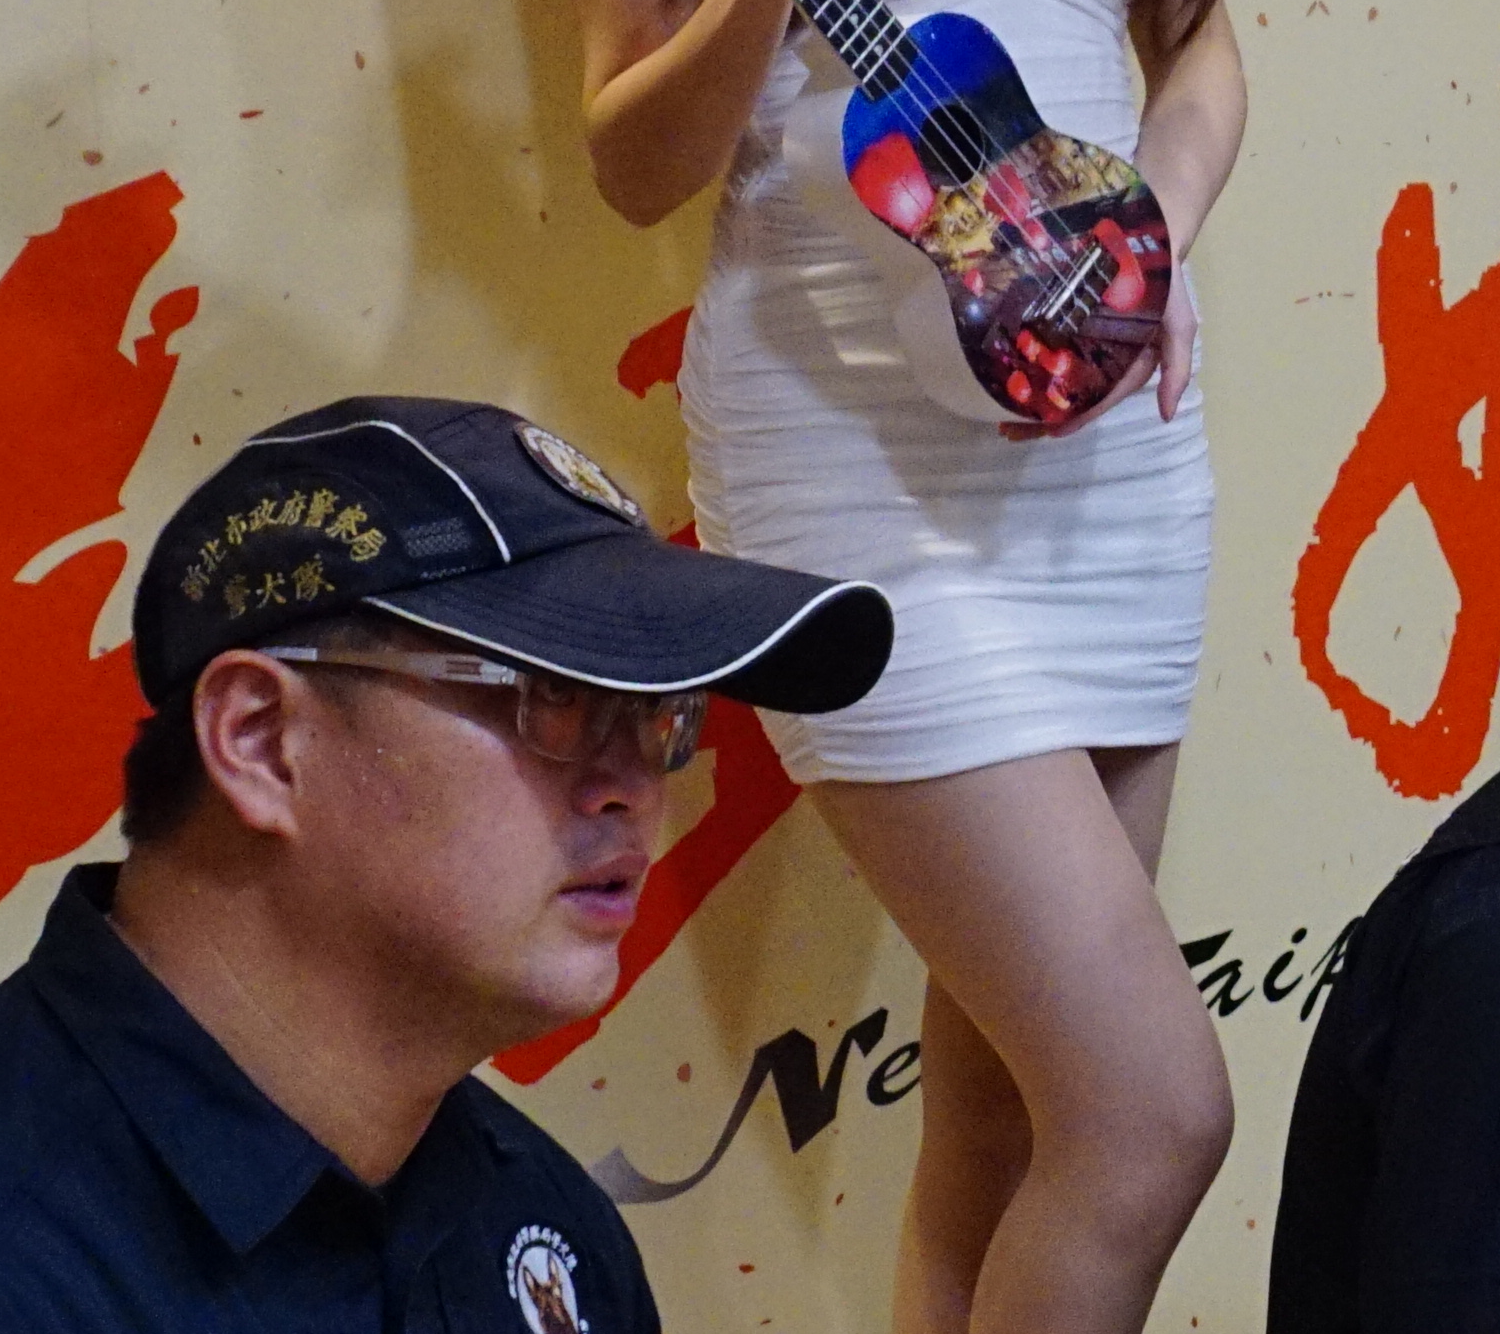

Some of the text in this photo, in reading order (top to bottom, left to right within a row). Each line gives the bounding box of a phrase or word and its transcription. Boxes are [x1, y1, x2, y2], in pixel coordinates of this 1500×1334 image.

[181, 487, 388, 602] 新北市政府警察局
[222, 553, 336, 619] 警犬隊
[591, 1006, 922, 1204] Ne
